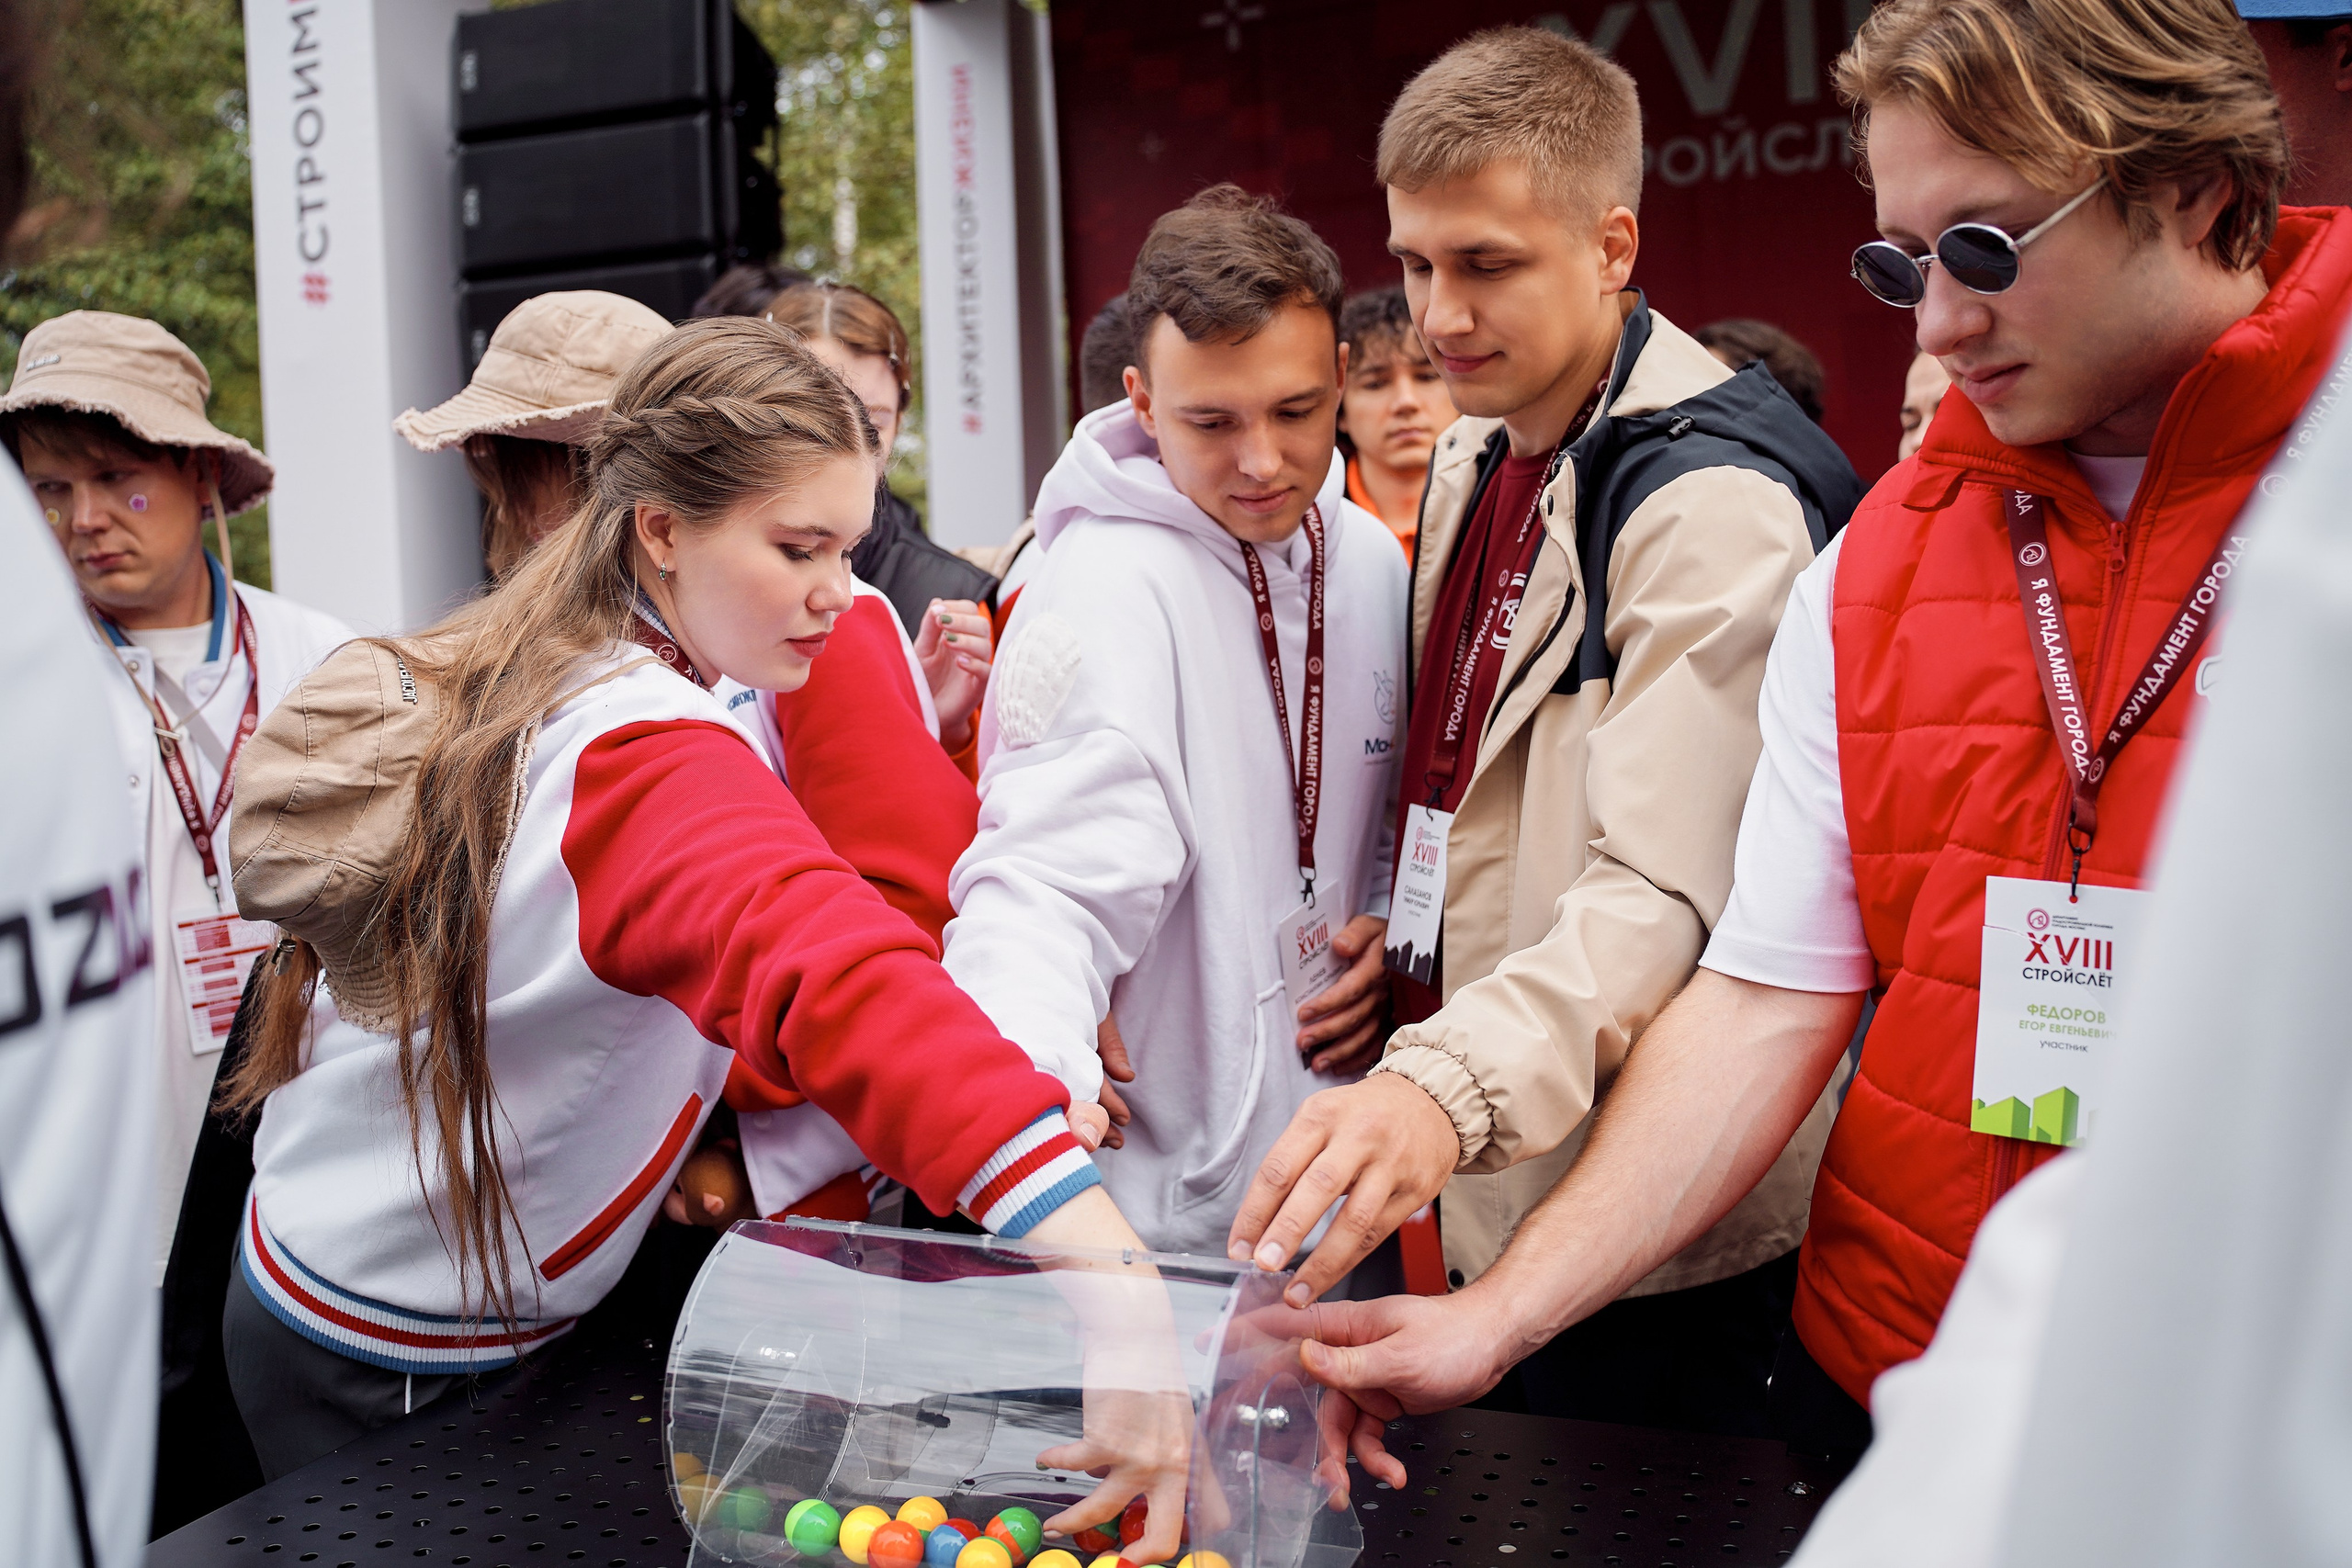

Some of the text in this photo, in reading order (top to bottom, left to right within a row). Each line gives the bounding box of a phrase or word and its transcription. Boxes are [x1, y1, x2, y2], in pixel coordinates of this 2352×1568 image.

[288, 0, 332, 306] #СТРОИМ
[1312, 576, 1324, 629] ГОРОДА
[2031, 577, 2049, 590] Я
[2035, 592, 2075, 702] ФУНДАМЕНТ
[2108, 535, 2252, 744] Я ФУНДАМЕНТ ГОРОДА
[1443, 596, 1498, 741] Я ФУНДАМЕНТ ГОРОДА
[1310, 685, 1320, 694] Я
[1306, 695, 1320, 778] ФУНДАМЕНТ
[1412, 842, 1439, 866] XVIII
[1298, 921, 1329, 960] XVIII
[2024, 931, 2112, 971] XVIII
[2022, 967, 2113, 987] СТРОЙСЛЁТ
[2019, 1020, 2046, 1031] ЕГОР
[2027, 1003, 2107, 1024] ФЕДОРОВ
[2040, 1040, 2088, 1052] участник
